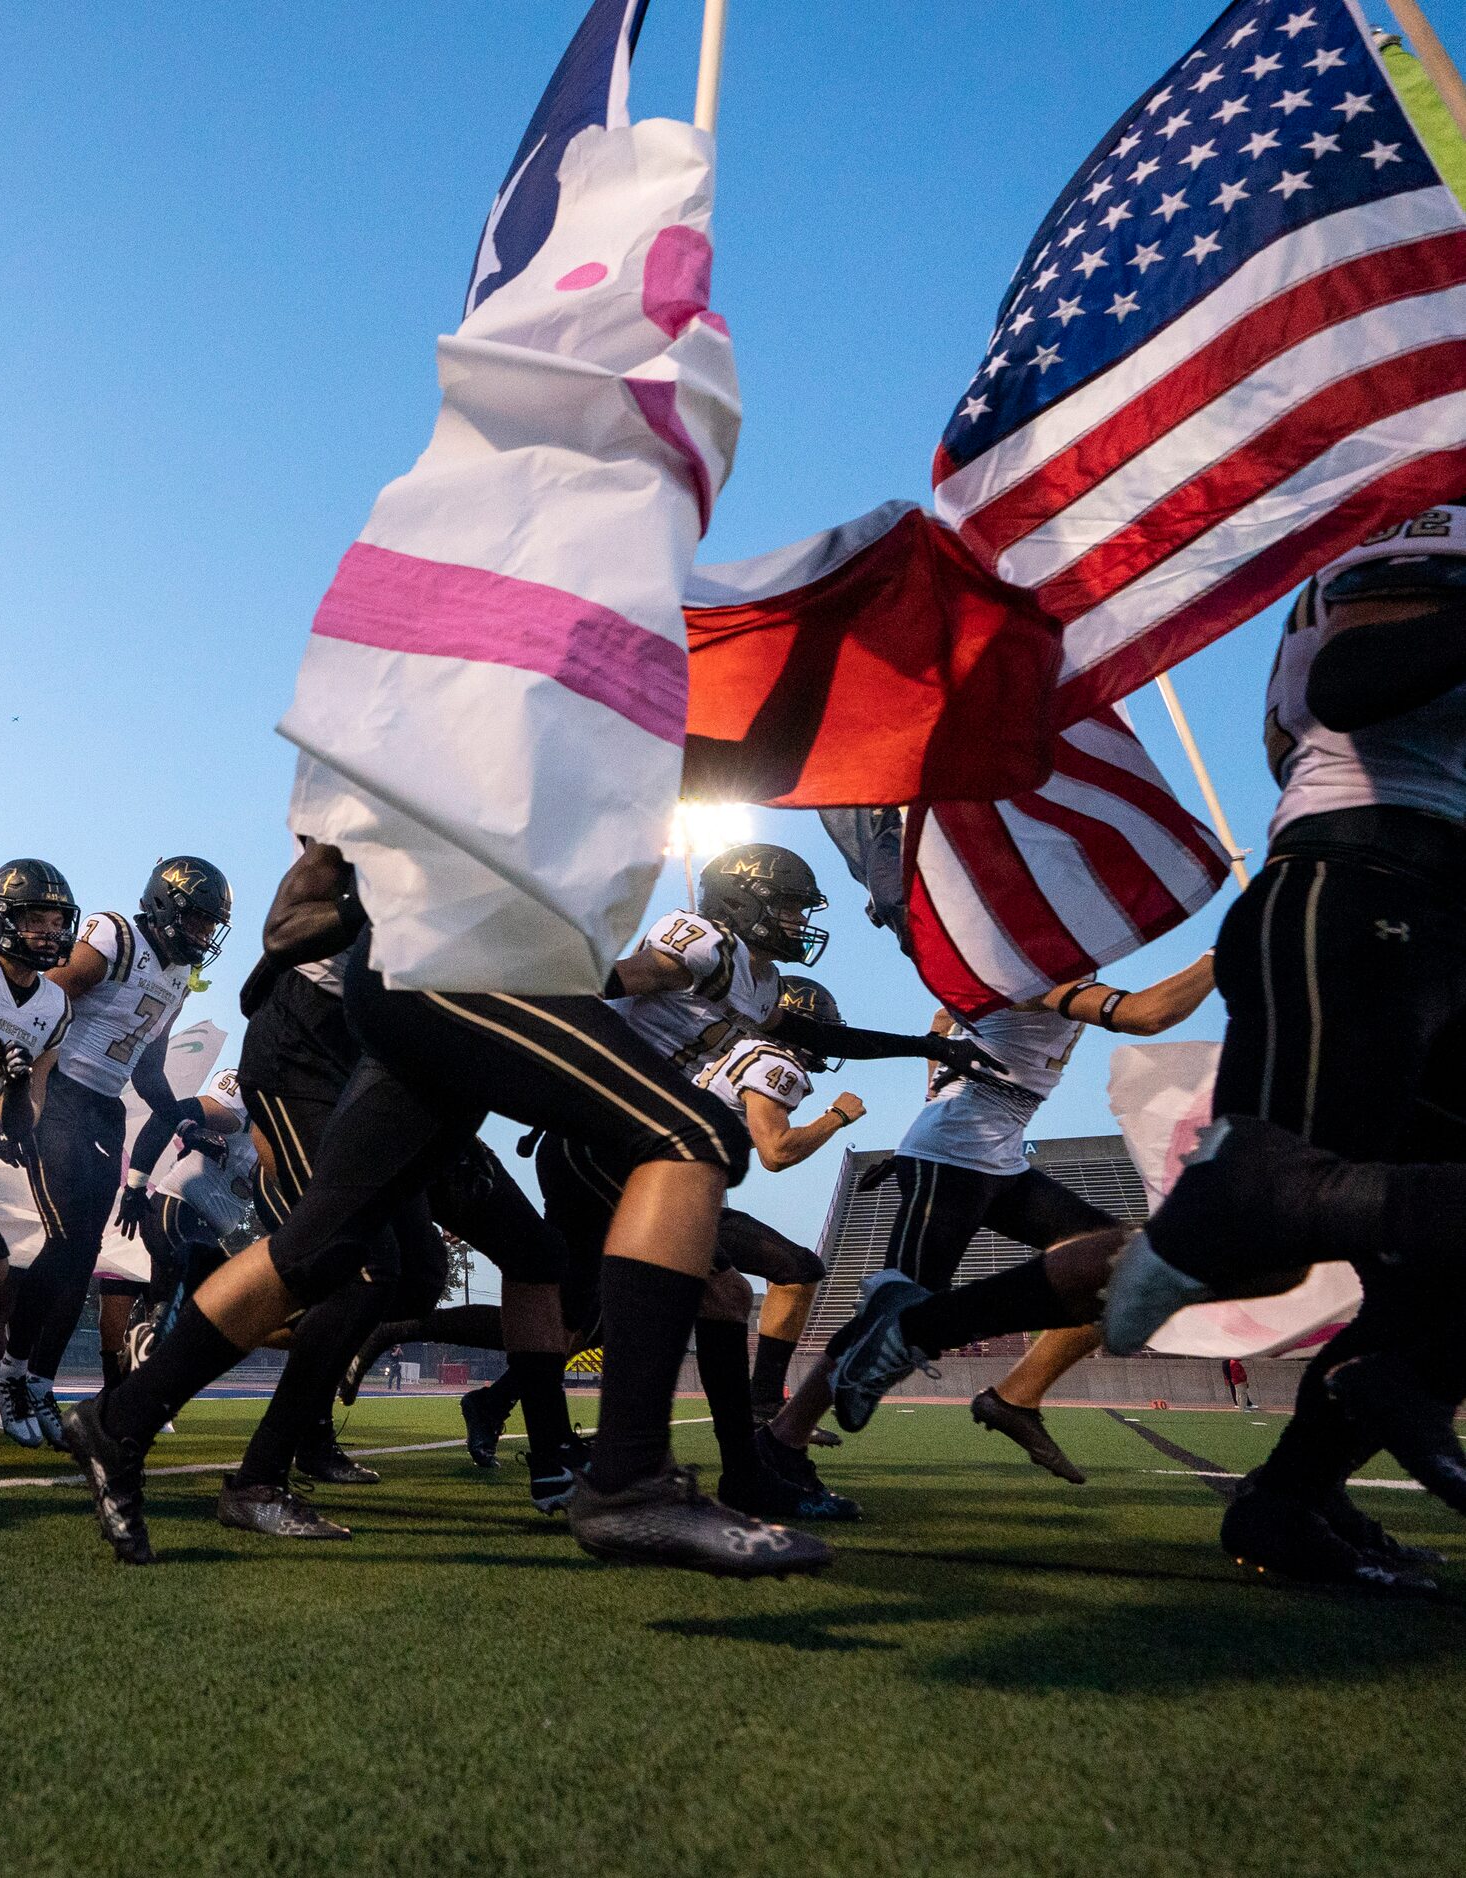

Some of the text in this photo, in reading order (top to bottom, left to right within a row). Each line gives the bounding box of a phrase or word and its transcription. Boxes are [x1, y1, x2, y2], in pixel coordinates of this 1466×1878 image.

[161, 860, 207, 895] M
[721, 848, 782, 879] M
[81, 920, 100, 943] 7
[660, 918, 707, 952] 17
[778, 984, 817, 1012] M
[105, 993, 167, 1064] 7
[765, 1065, 798, 1096] 43
[1025, 1142, 1037, 1155] A
